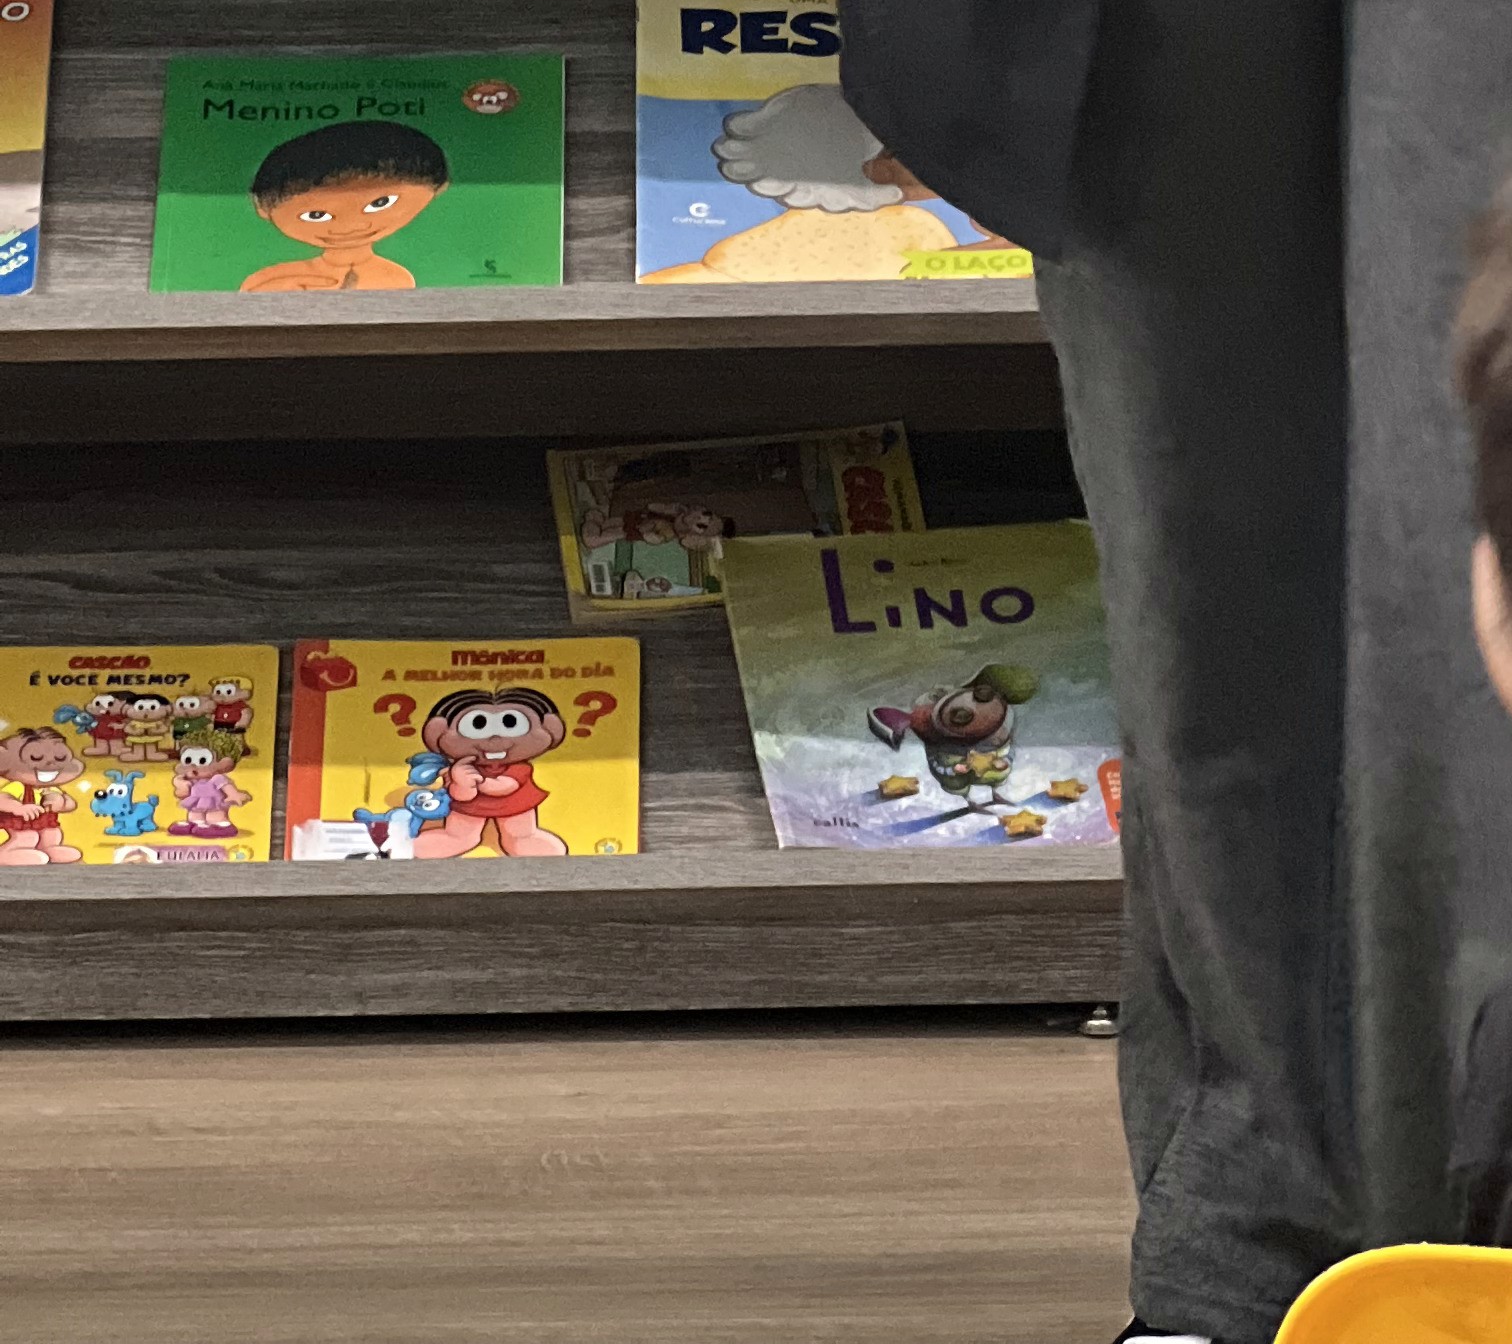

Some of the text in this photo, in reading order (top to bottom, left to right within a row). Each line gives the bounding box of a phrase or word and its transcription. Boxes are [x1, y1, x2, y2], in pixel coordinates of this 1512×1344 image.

[679, 7, 841, 58] RES
[203, 98, 340, 122] Menino
[925, 252, 1027, 275] O LAÇO
[106, 673, 190, 687] MESMO?
